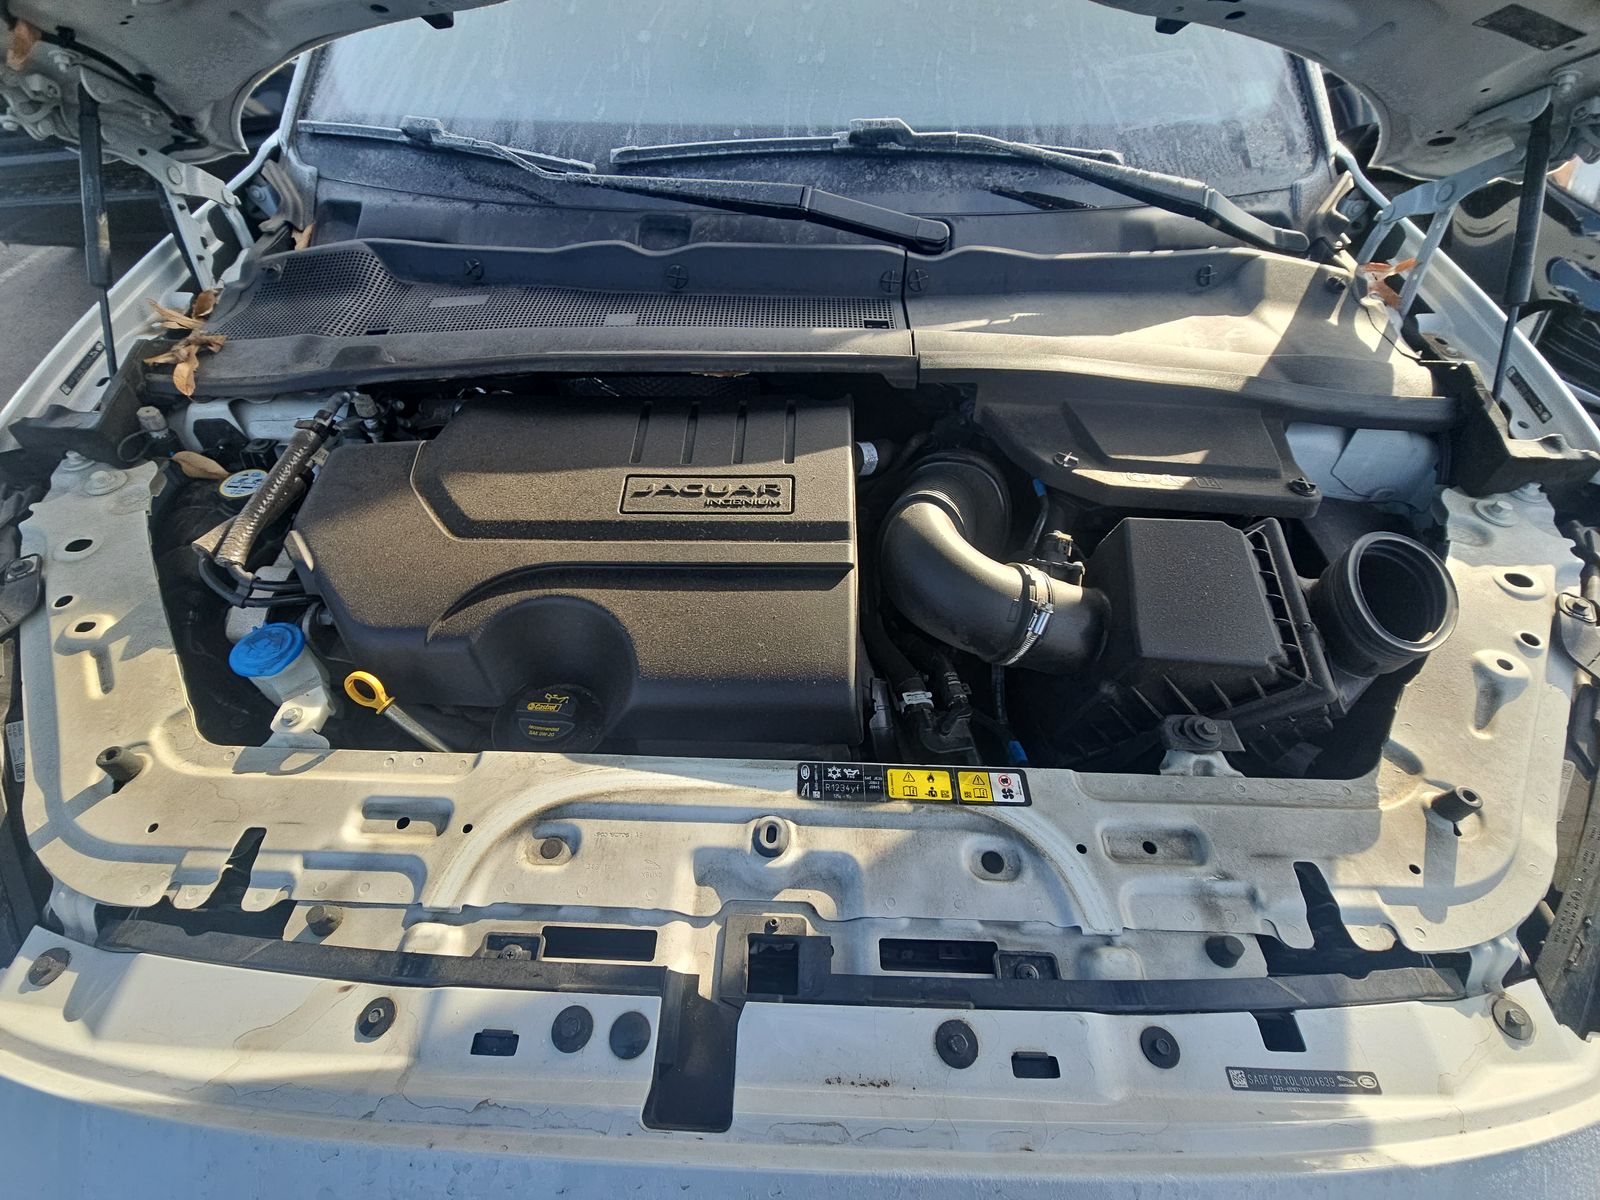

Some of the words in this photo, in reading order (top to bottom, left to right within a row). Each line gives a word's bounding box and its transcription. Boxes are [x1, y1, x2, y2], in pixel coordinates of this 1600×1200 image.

[630, 483, 782, 499] JAGUAR
[703, 498, 782, 509] INGENIUM
[825, 783, 860, 793] R1234yf
